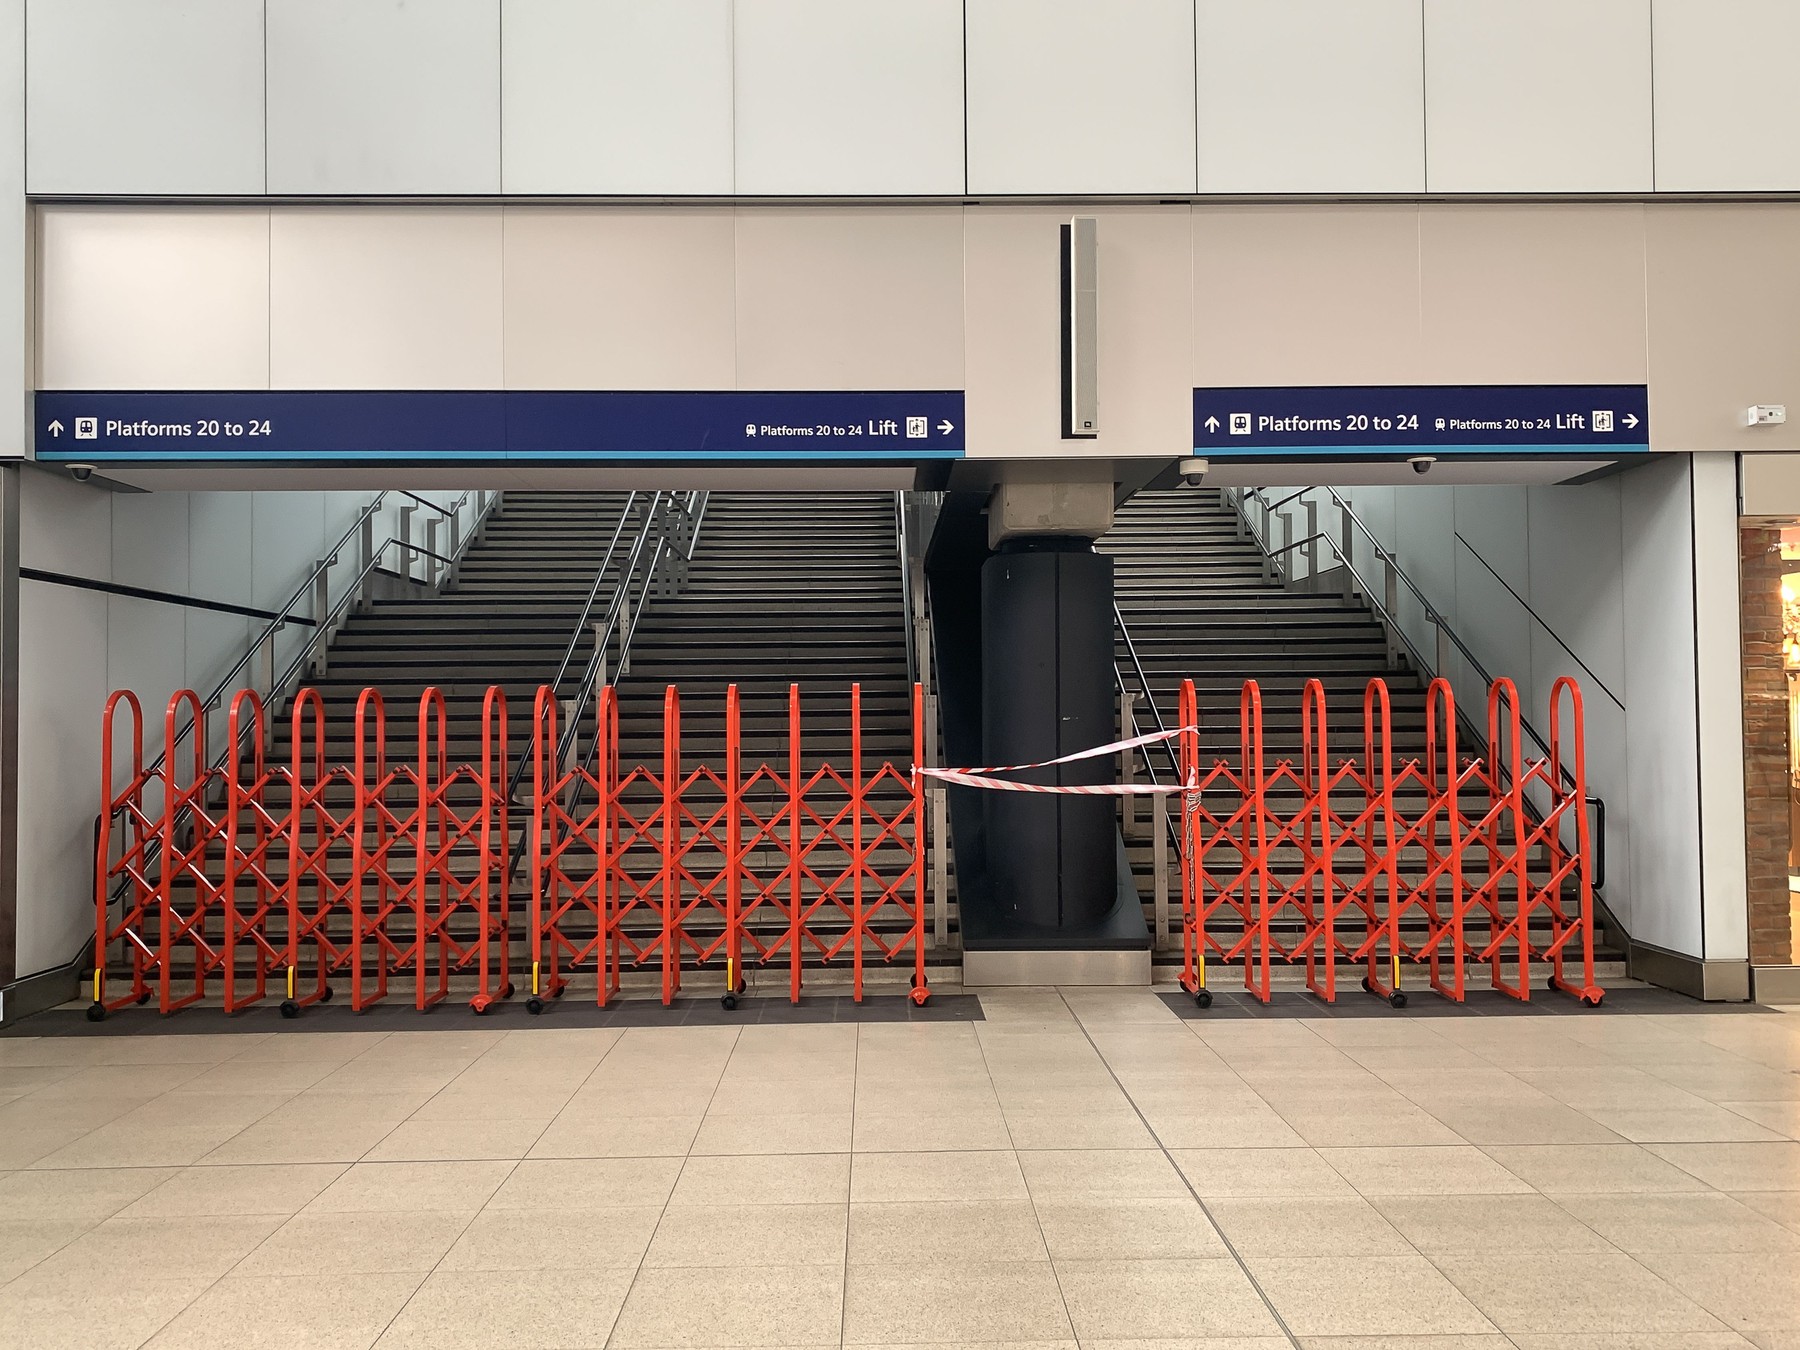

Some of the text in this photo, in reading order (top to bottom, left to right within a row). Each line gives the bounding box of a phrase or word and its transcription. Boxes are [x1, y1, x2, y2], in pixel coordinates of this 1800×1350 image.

[106, 419, 272, 437] Platforms 20 to 24
[760, 419, 898, 436] Platforms 20 to 24 Lift
[1258, 414, 1419, 432] Platforms 20 to 24
[1449, 413, 1586, 430] Platforms 20 to 24 Lift
